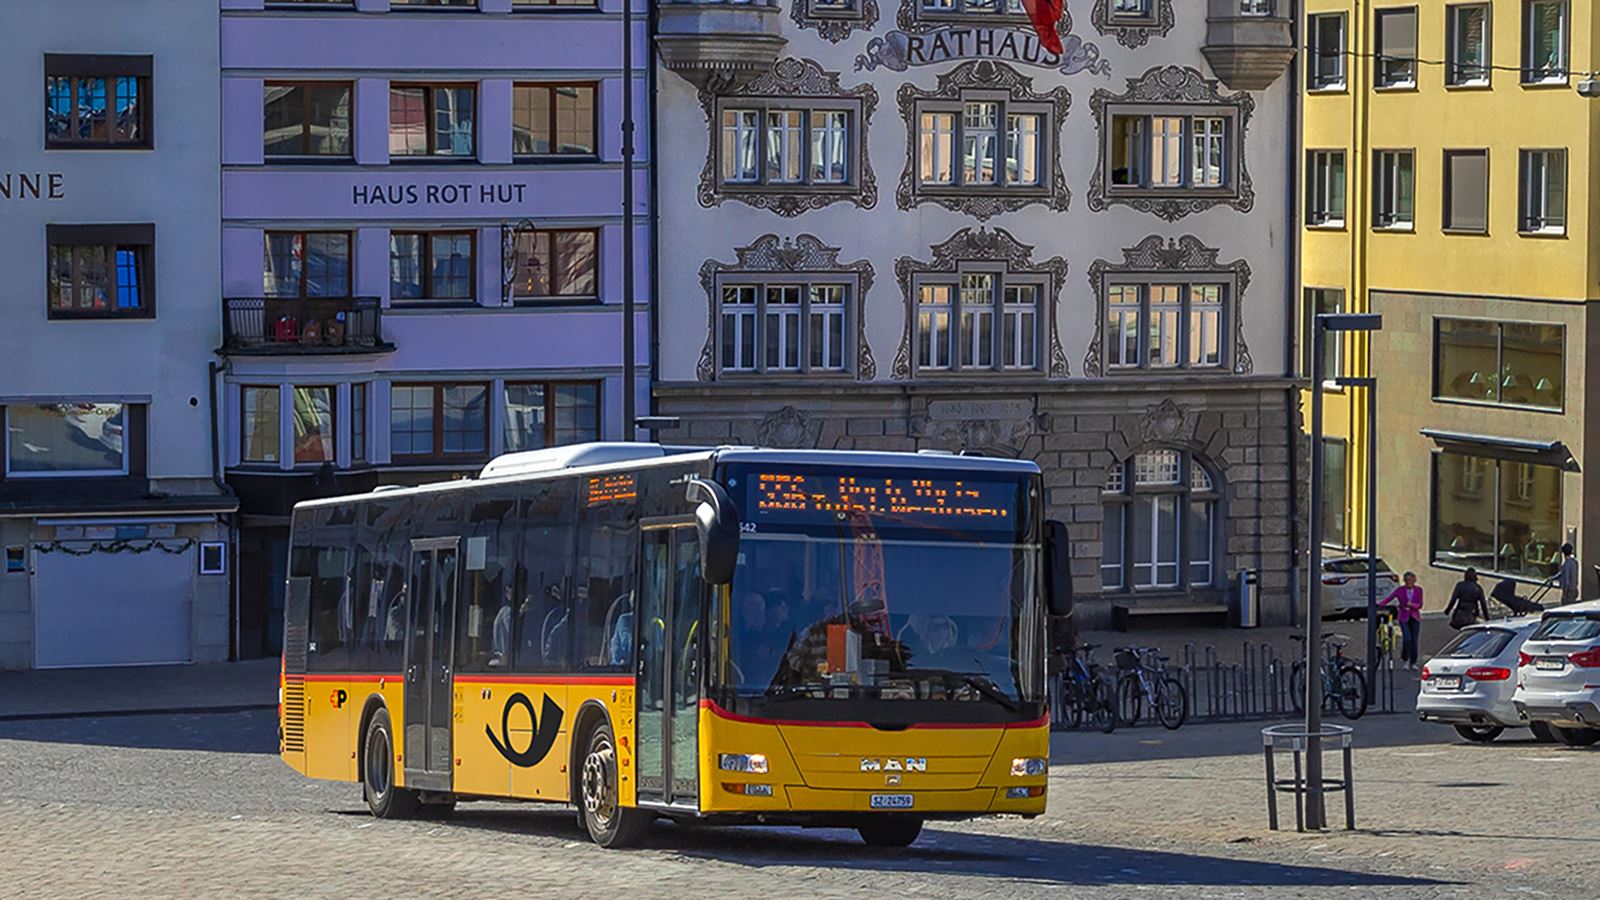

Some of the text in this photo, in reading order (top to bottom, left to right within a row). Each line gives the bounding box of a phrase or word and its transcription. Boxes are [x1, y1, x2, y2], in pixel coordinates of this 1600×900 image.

[907, 30, 1061, 65] RATHAUS
[353, 184, 527, 205] HAUS ROT HUT
[860, 757, 927, 772] MAN
